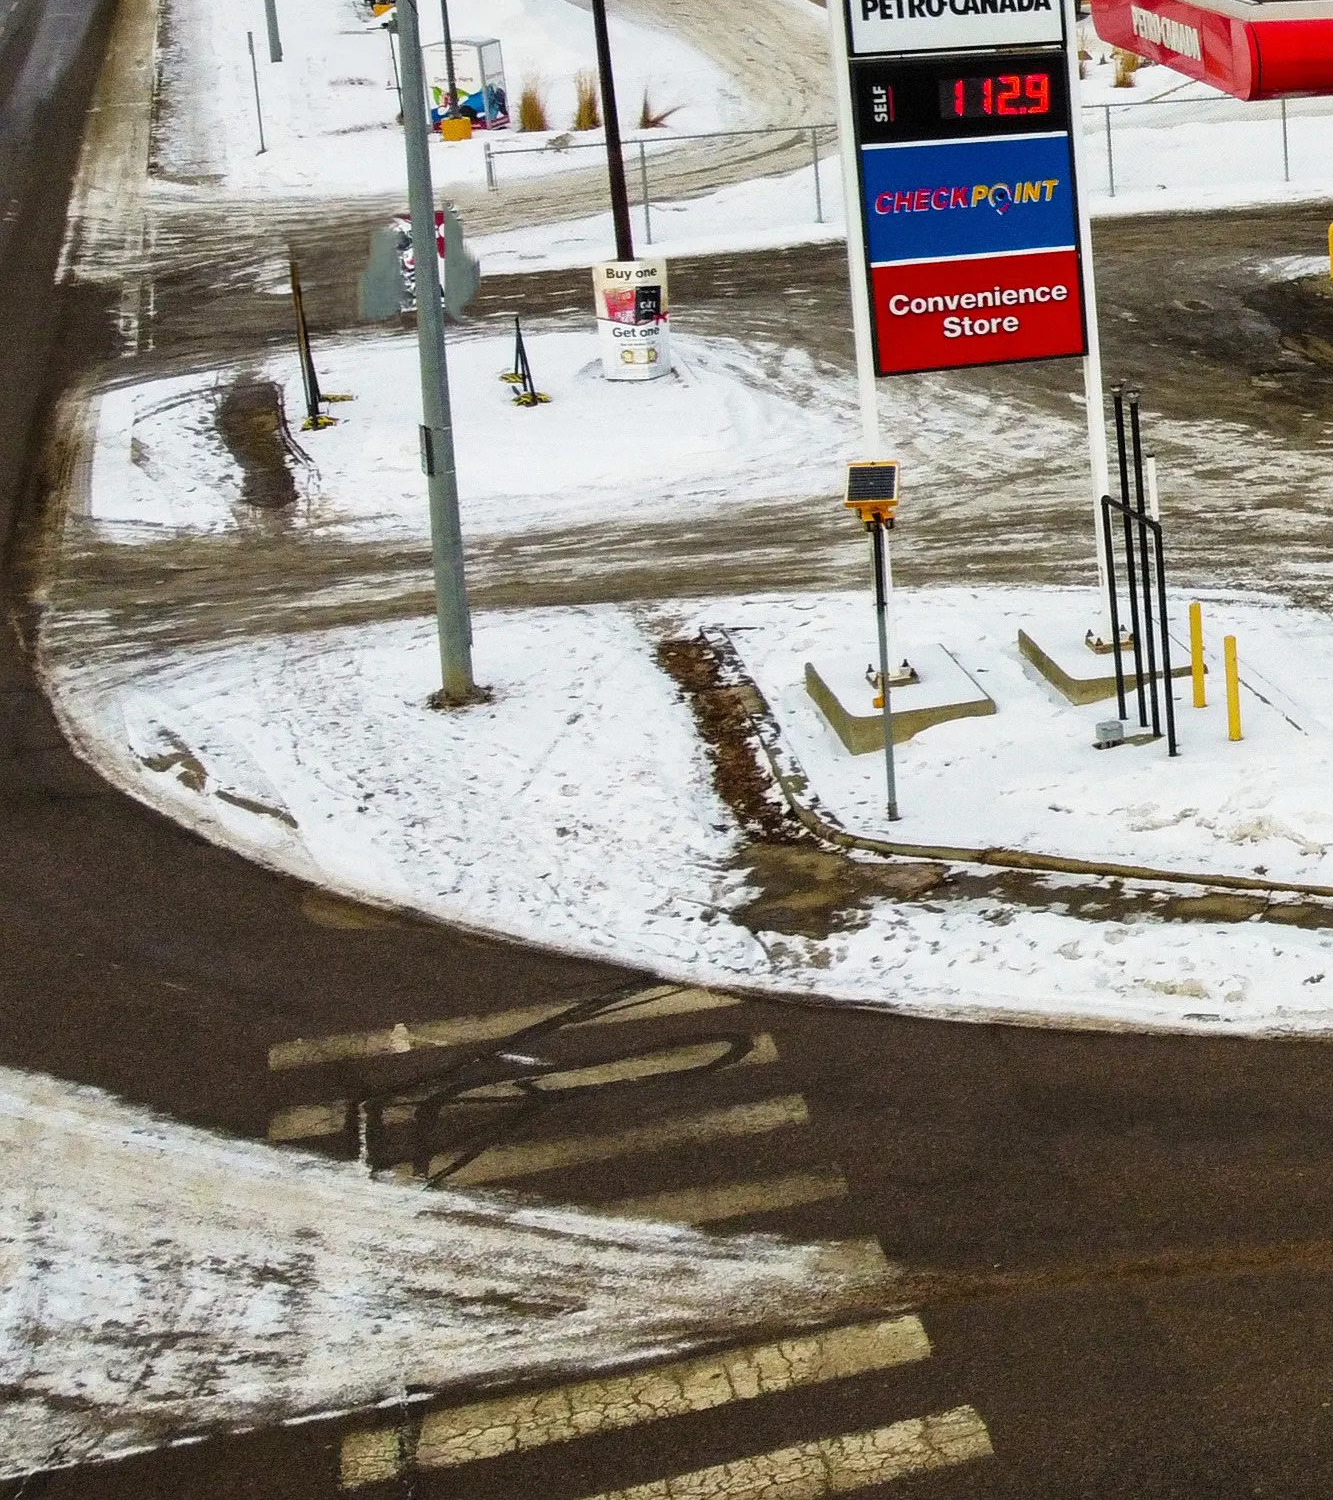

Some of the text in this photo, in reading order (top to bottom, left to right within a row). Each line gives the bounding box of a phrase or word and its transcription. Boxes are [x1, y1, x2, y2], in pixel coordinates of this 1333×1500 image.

[872, 85, 889, 123] SELF
[954, 73, 1049, 116] 112.9
[875, 179, 1059, 215] CHECKPOINT
[606, 267, 658, 280] Buy one
[889, 284, 1068, 316] Convenience
[612, 326, 660, 338] Get one
[943, 315, 1019, 338] Store
